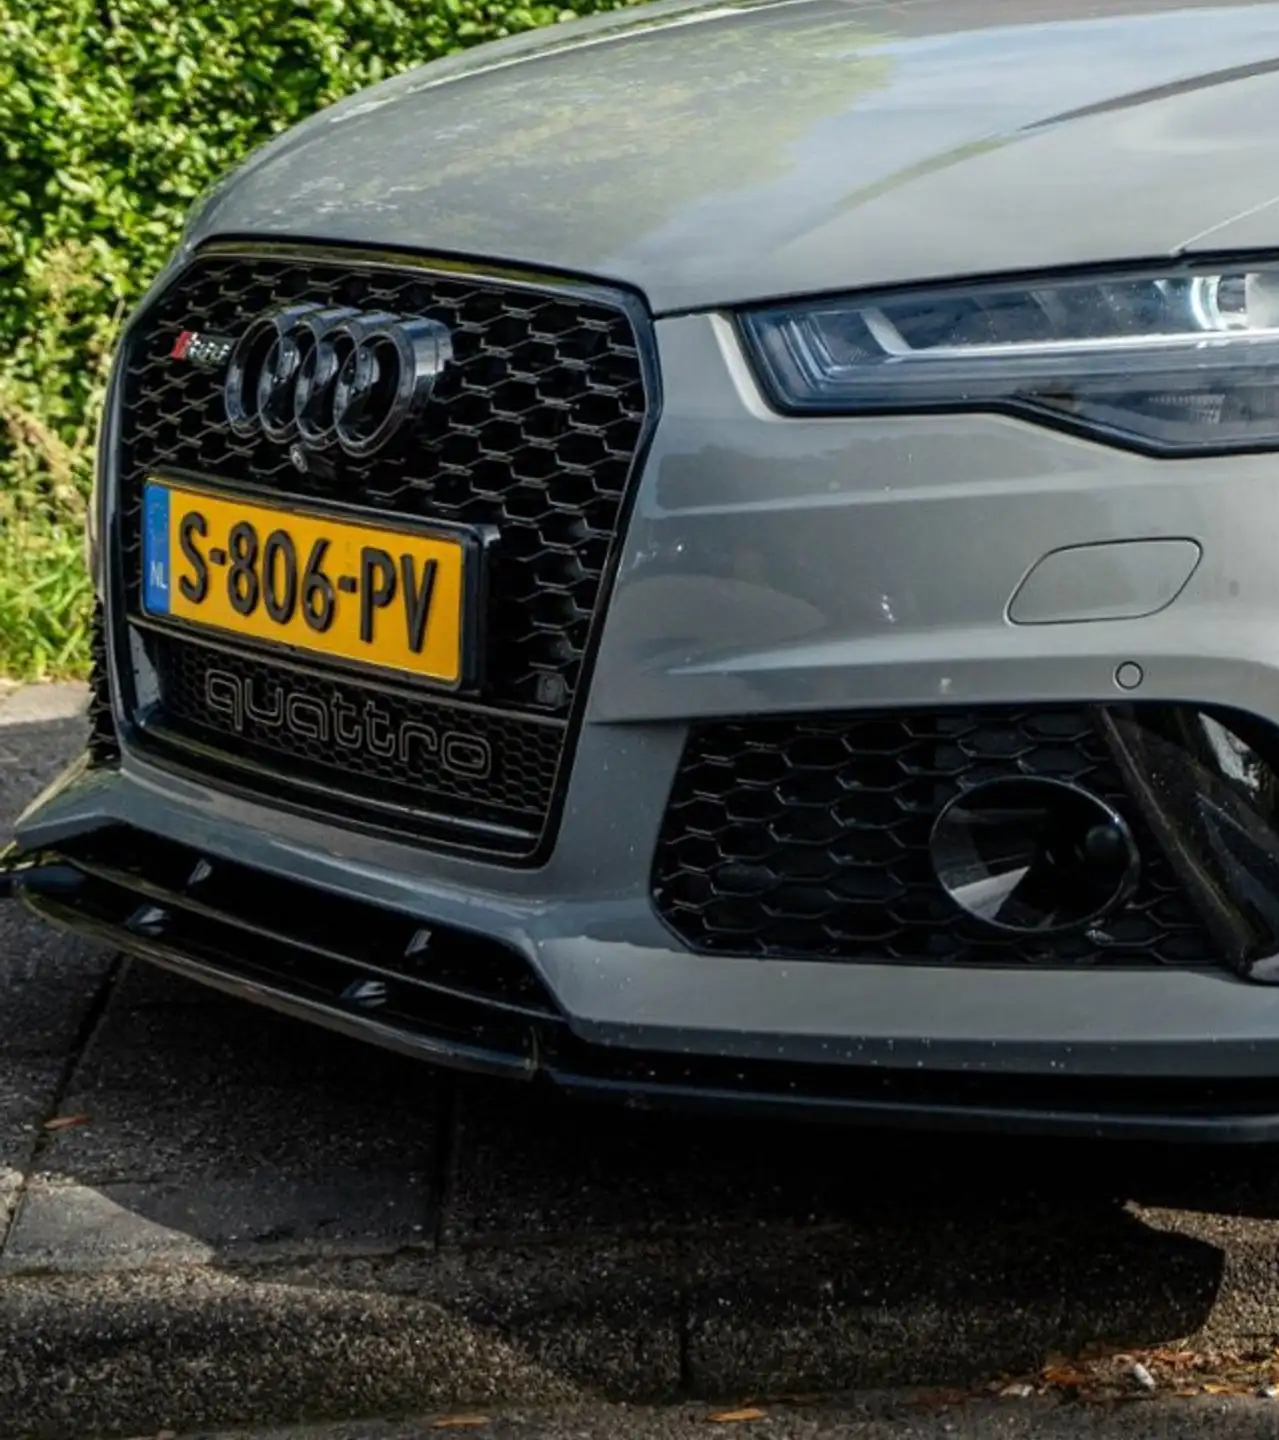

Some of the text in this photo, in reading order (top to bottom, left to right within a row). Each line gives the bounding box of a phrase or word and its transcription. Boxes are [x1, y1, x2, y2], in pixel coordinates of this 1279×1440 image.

[151, 560, 168, 590] NL
[178, 510, 439, 655] S-806-PV
[205, 668, 492, 780] quattro
